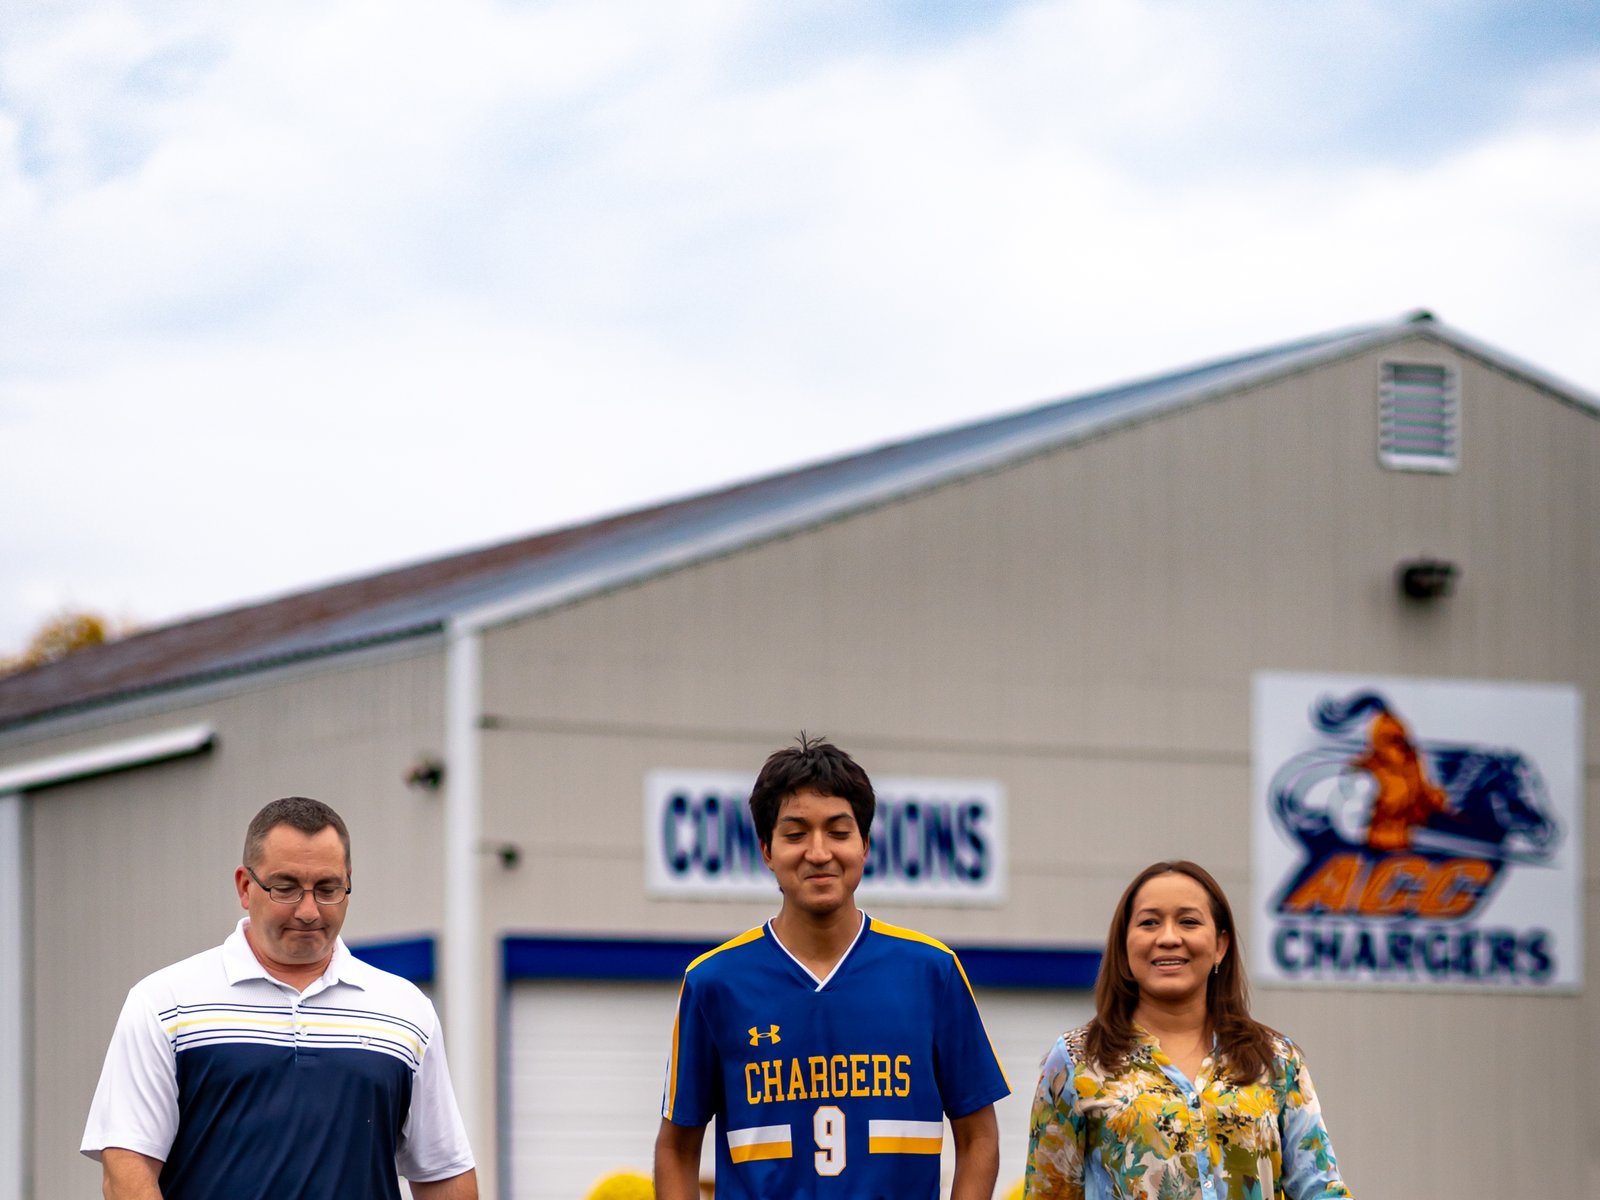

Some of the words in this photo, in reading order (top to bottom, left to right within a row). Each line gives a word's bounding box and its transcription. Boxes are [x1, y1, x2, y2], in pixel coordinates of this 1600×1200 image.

[663, 793, 988, 879] CONIONS
[1274, 926, 1554, 980] CHARGERS
[745, 1054, 912, 1105] CHARGERS
[813, 1105, 846, 1176] 9
